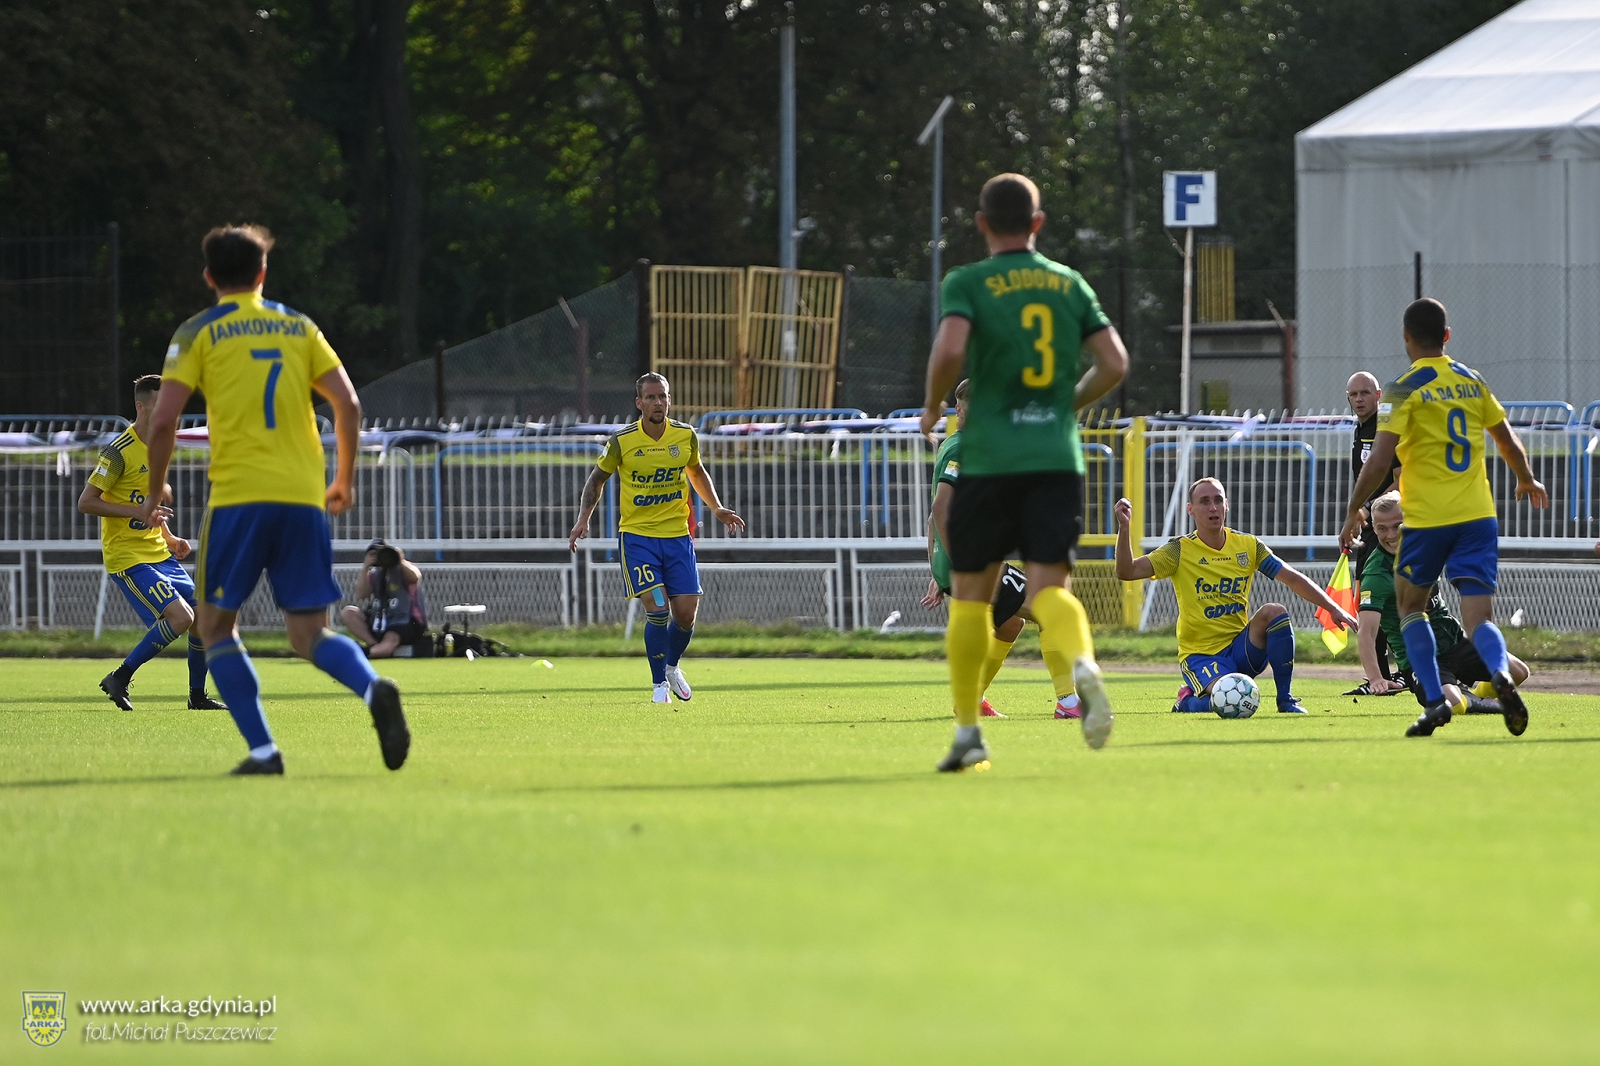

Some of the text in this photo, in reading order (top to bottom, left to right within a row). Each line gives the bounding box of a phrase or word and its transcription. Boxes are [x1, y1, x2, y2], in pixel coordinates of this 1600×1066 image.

[1175, 174, 1203, 221] F
[209, 317, 307, 345] JANKOWSKI
[1021, 303, 1054, 388] 3
[250, 348, 283, 430] 7
[1420, 389, 1437, 403] M.
[1436, 386, 1455, 400] DA
[631, 465, 686, 483] forBET
[633, 490, 683, 506] GDYNIA
[633, 564, 655, 586] 26
[1002, 568, 1028, 593] 21
[1195, 575, 1250, 594] forBET
[148, 580, 173, 604] 10
[1201, 661, 1219, 679] 17
